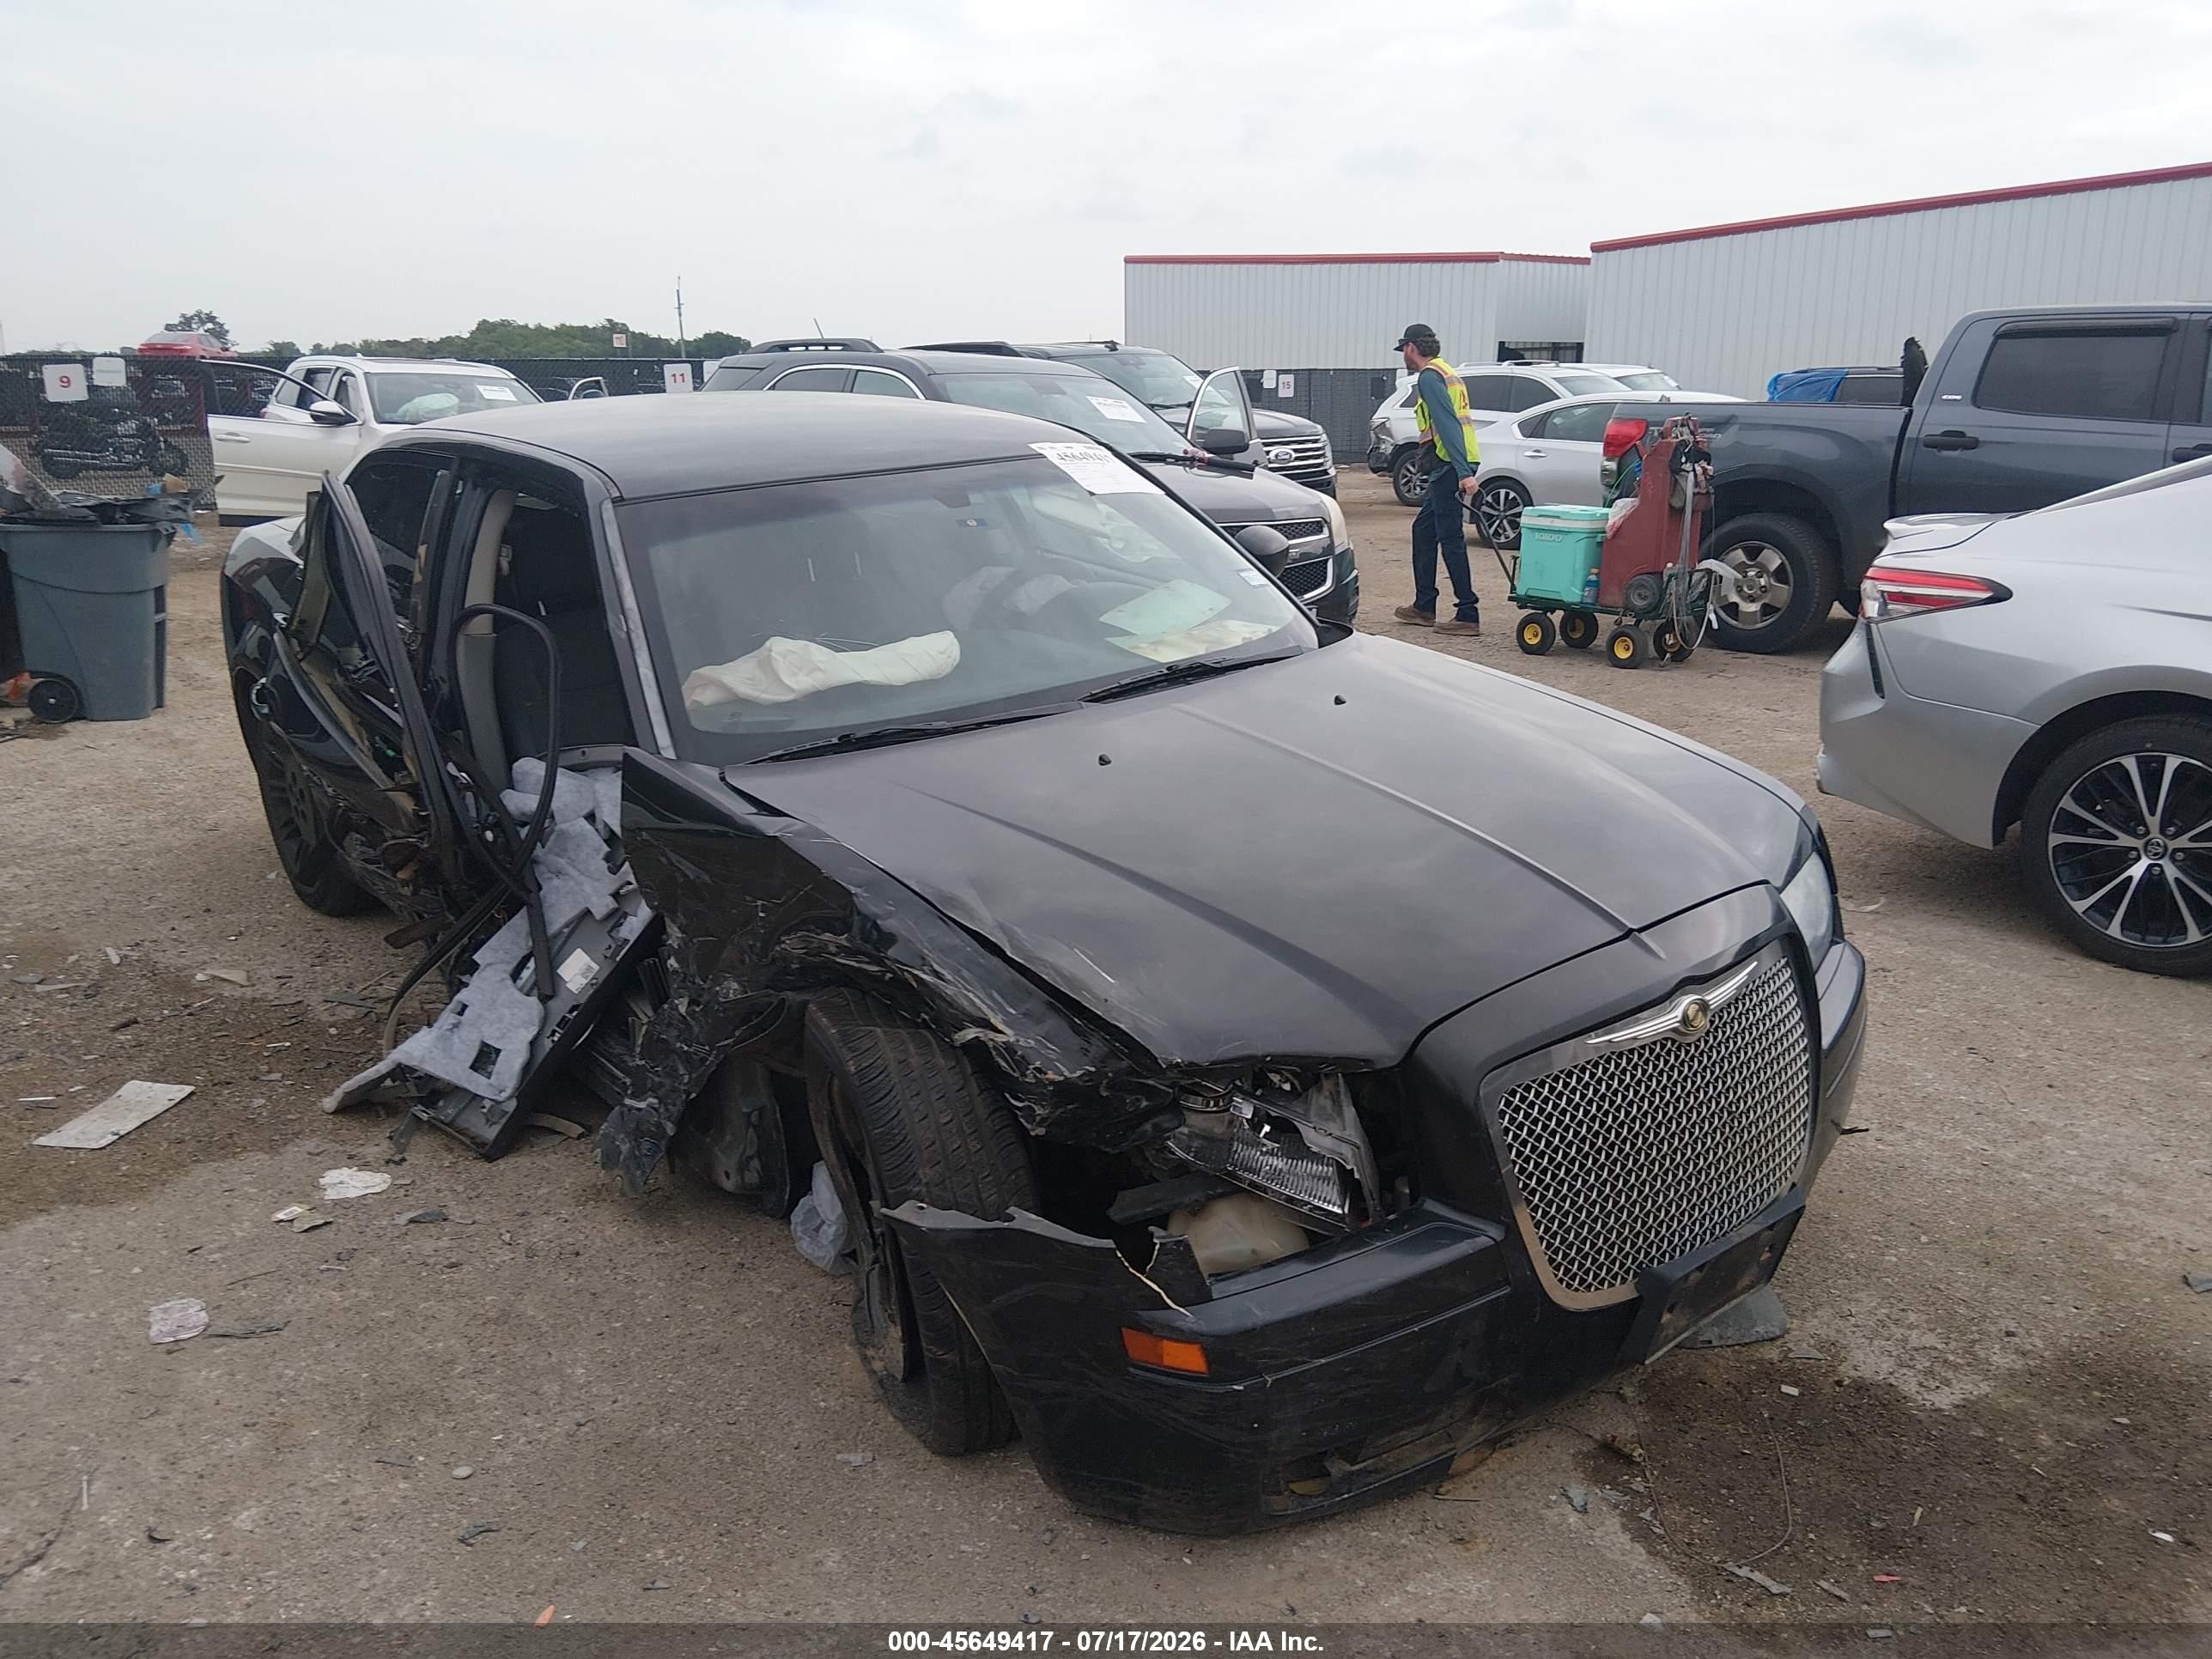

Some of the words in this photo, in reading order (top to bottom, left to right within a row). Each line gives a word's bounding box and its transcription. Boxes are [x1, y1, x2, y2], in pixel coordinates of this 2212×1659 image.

[59, 375, 71, 388] 9
[671, 373, 686, 384] 11
[1281, 380, 1291, 390] 15
